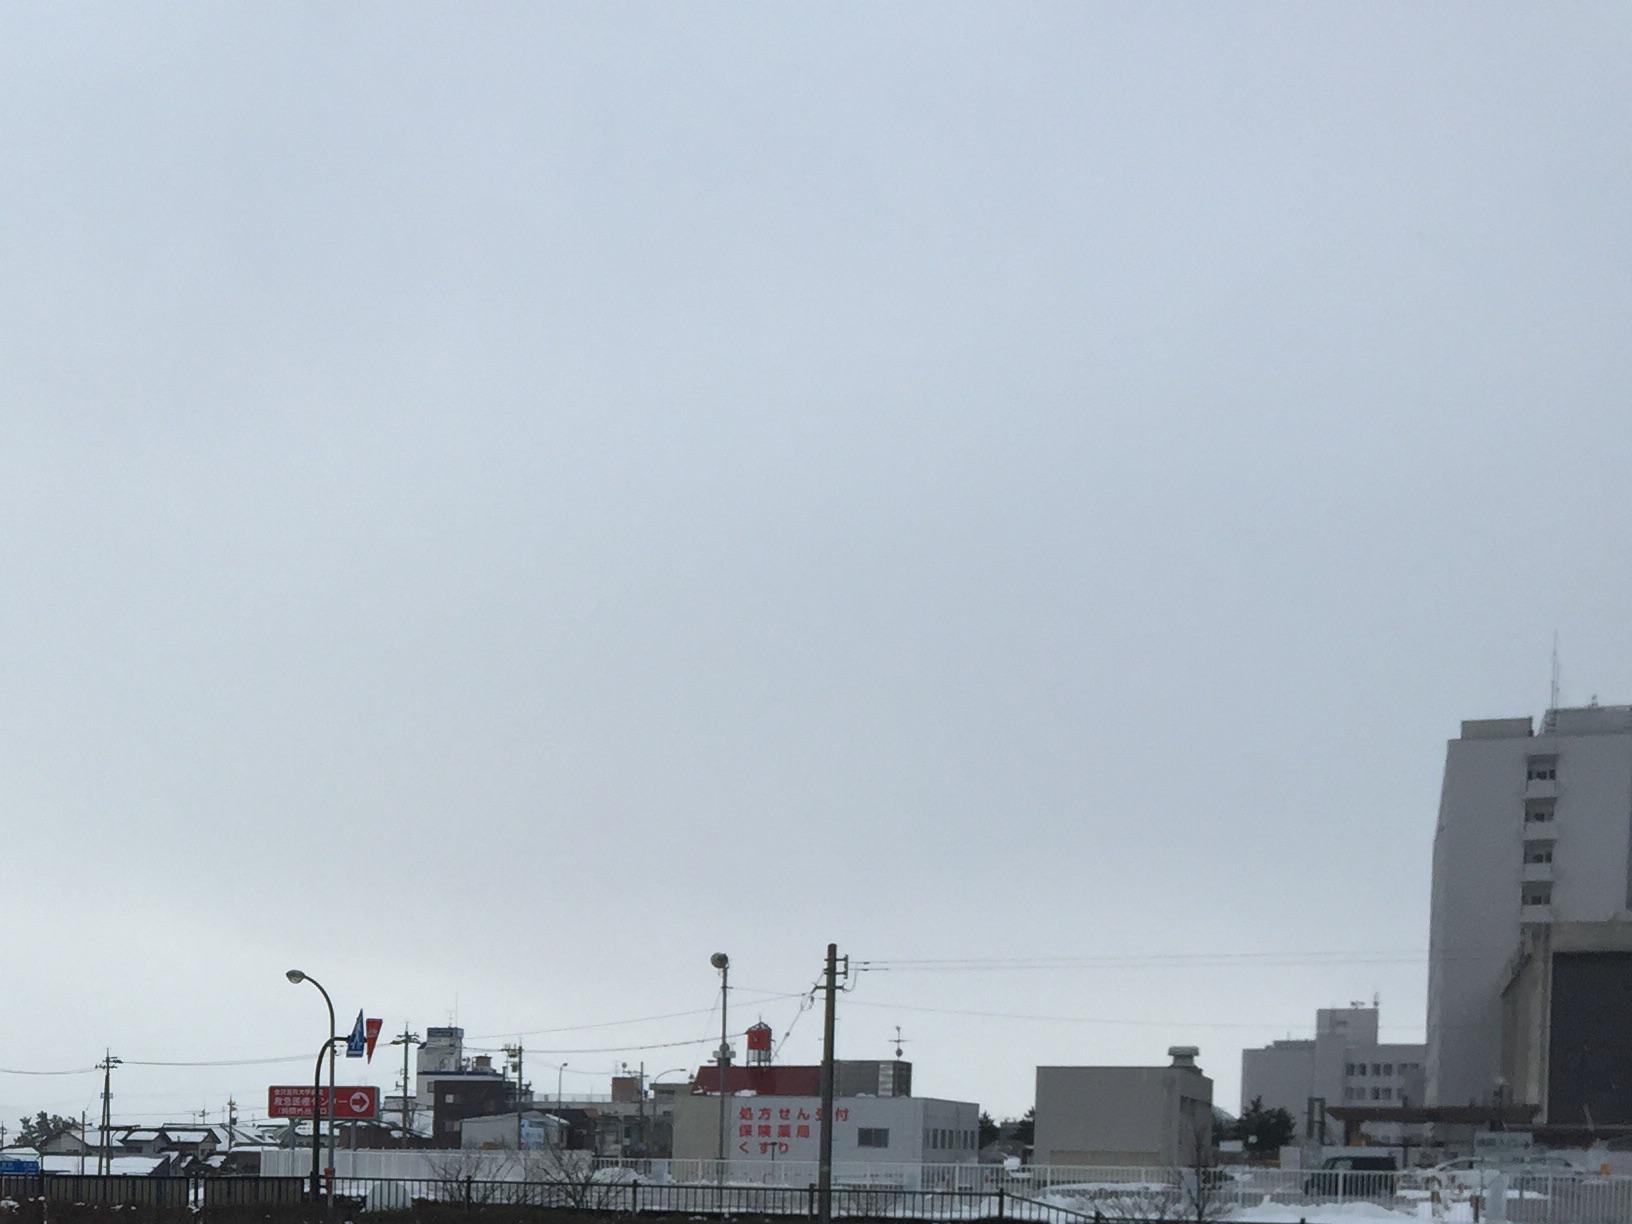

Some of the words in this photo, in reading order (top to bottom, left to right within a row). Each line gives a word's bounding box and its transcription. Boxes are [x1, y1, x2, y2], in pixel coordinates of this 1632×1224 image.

[273, 1097, 348, 1106] 救急医療ンー
[739, 1124, 810, 1138] 保険薬局
[739, 1141, 789, 1154] くすり
